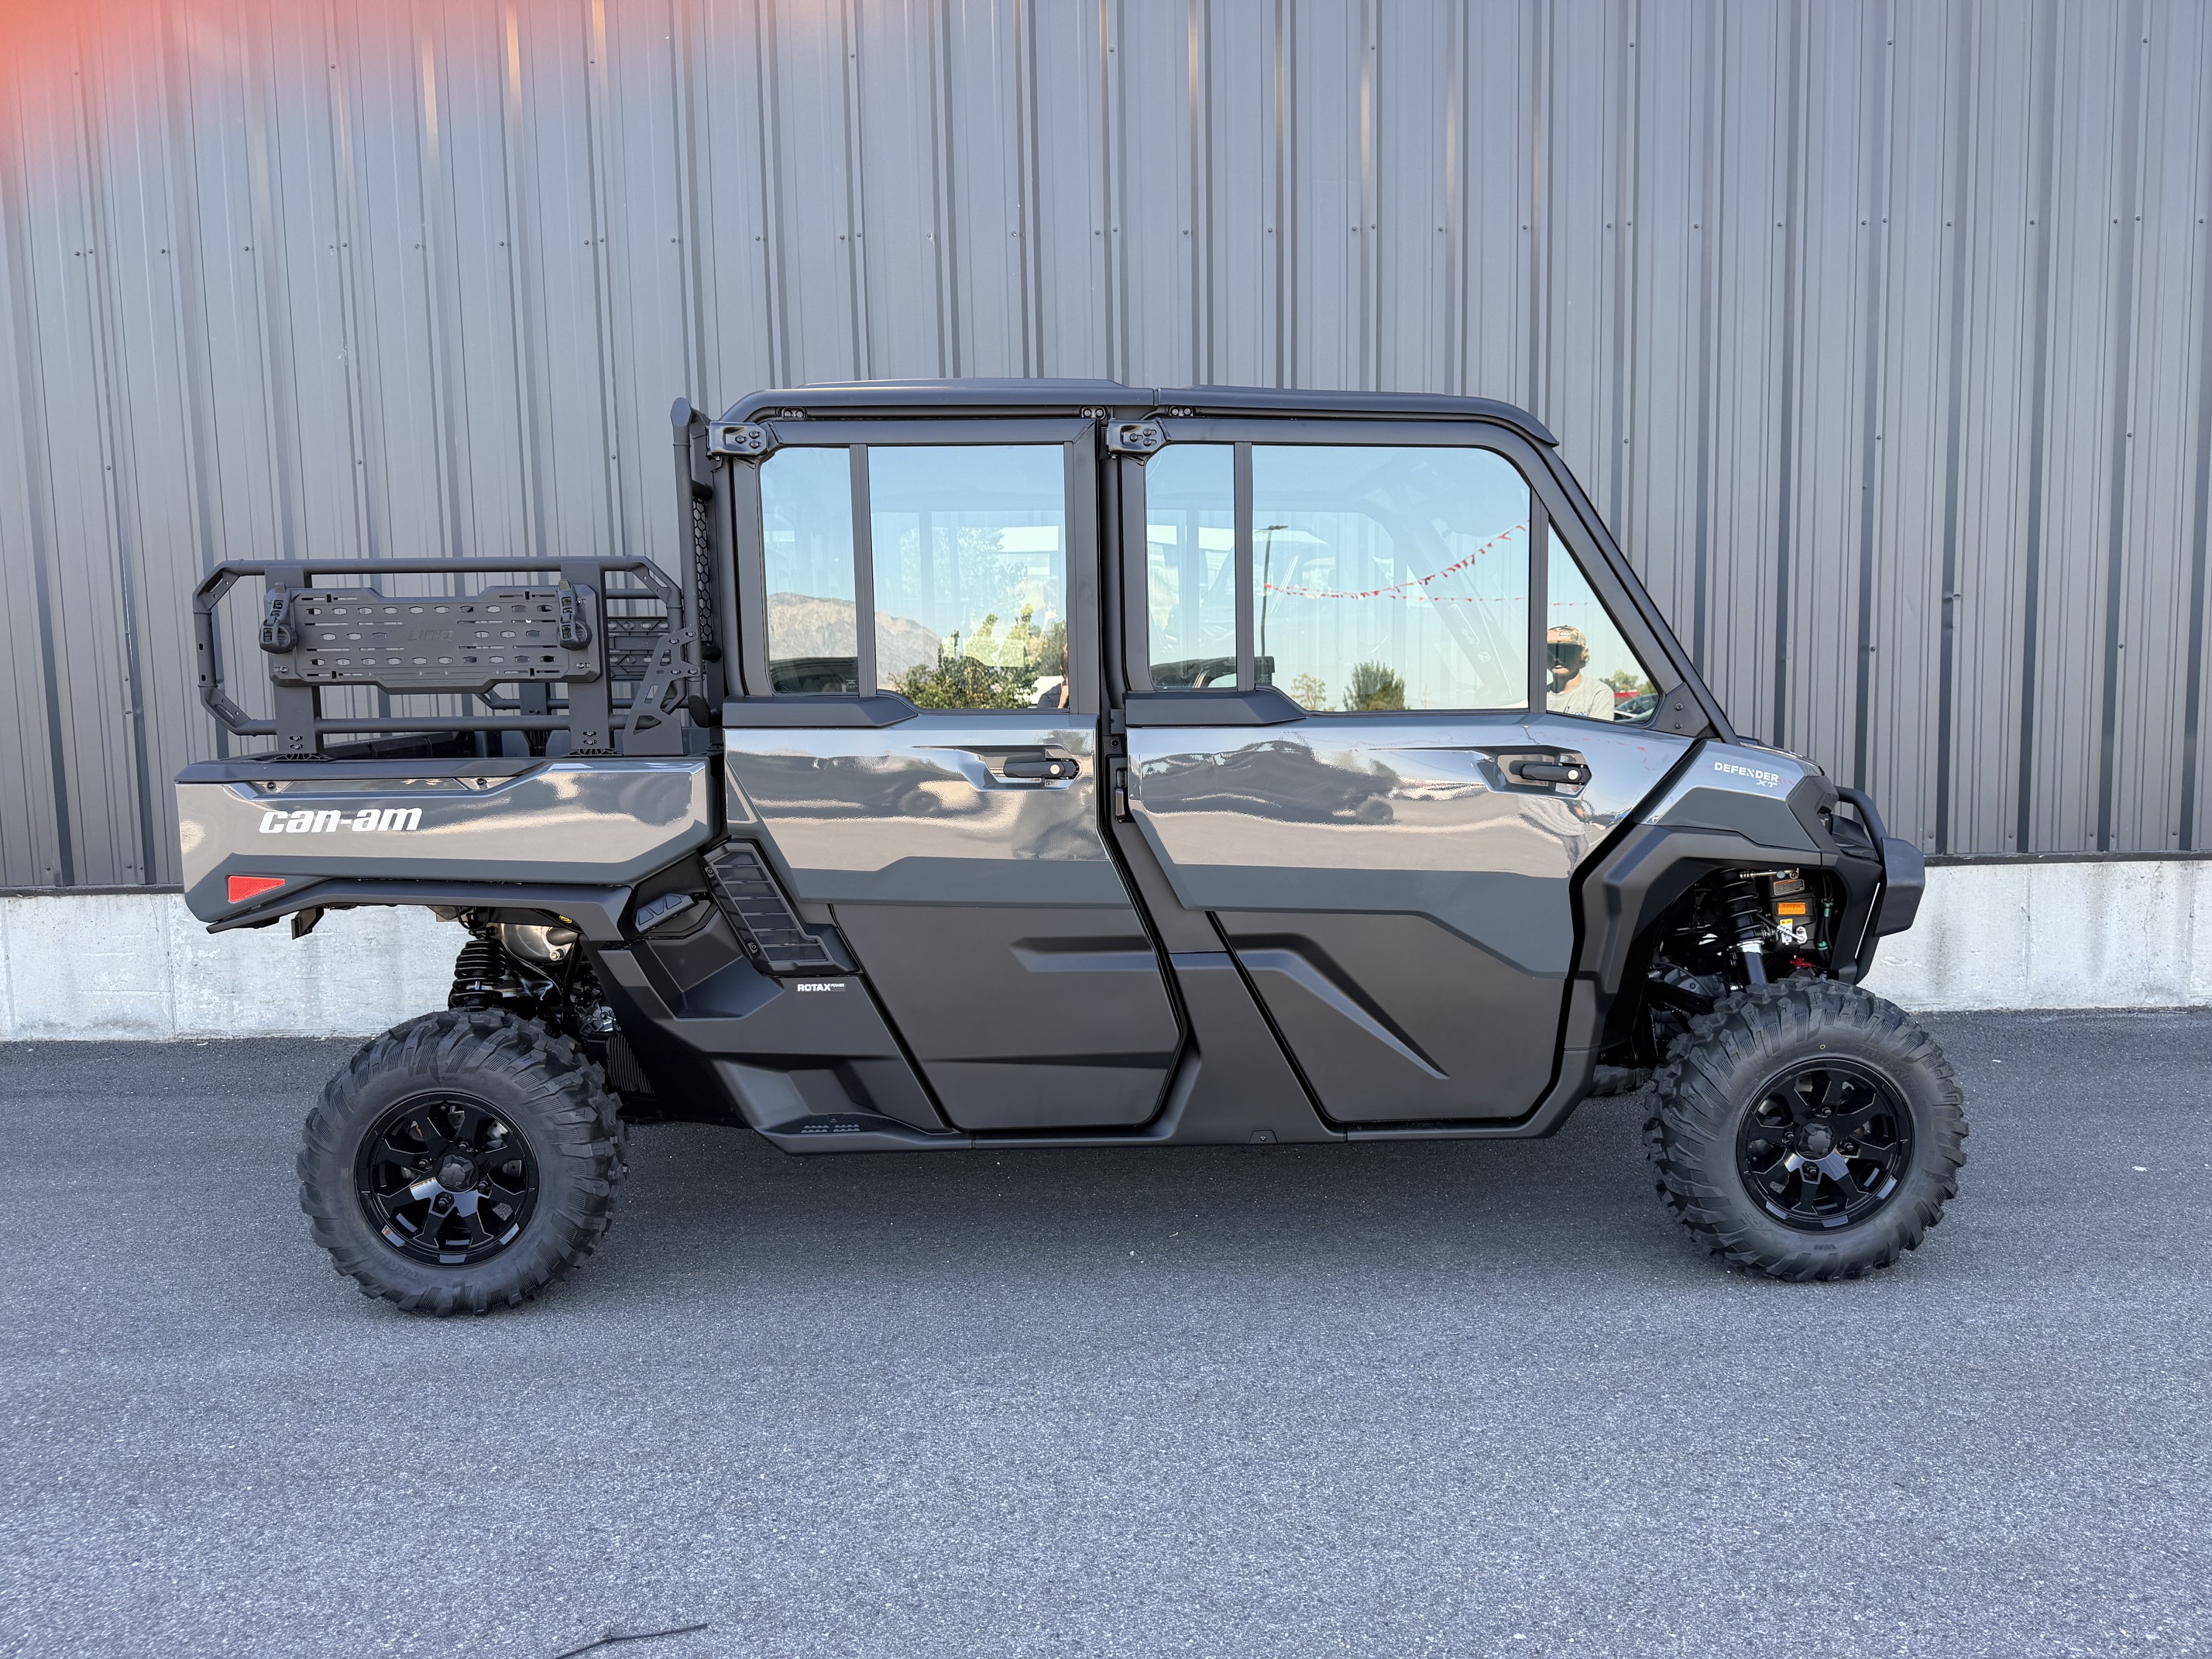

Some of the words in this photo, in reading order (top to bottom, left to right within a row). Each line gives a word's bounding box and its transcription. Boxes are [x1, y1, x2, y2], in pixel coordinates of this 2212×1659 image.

[1714, 761, 1779, 782] DEFENDER
[1756, 779, 1778, 788] XT
[259, 807, 423, 833] can-am
[797, 983, 831, 991] ROTAX
